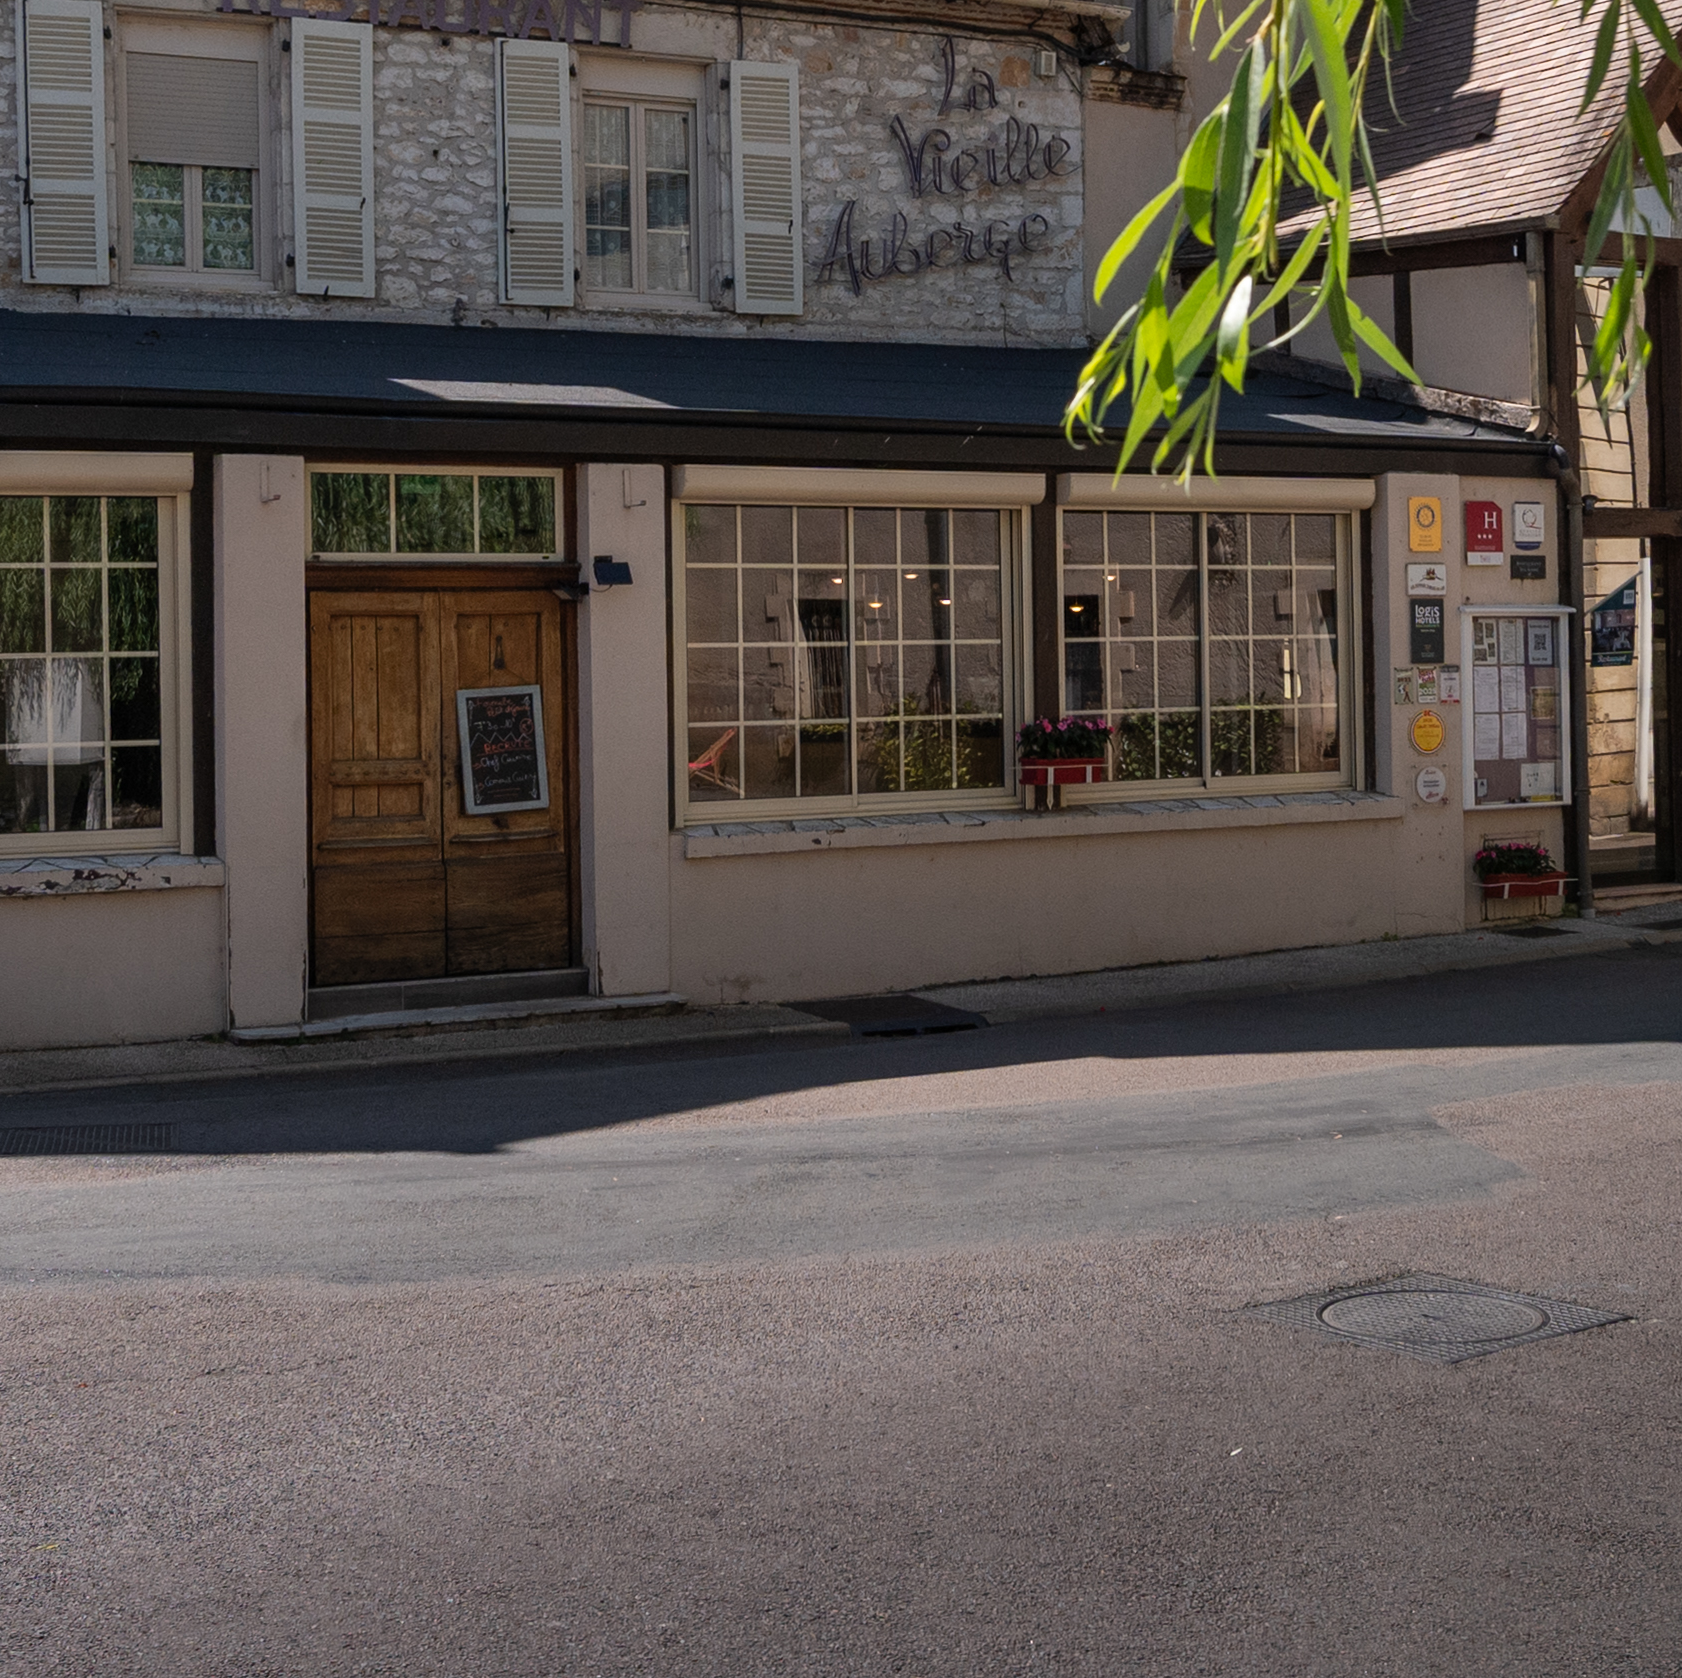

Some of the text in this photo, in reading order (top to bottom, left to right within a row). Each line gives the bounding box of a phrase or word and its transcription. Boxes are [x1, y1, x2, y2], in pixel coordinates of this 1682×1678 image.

[937, 35, 999, 117] La
[889, 113, 1083, 199] Vieille
[814, 199, 1055, 297] Auberge
[1483, 511, 1498, 530] H
